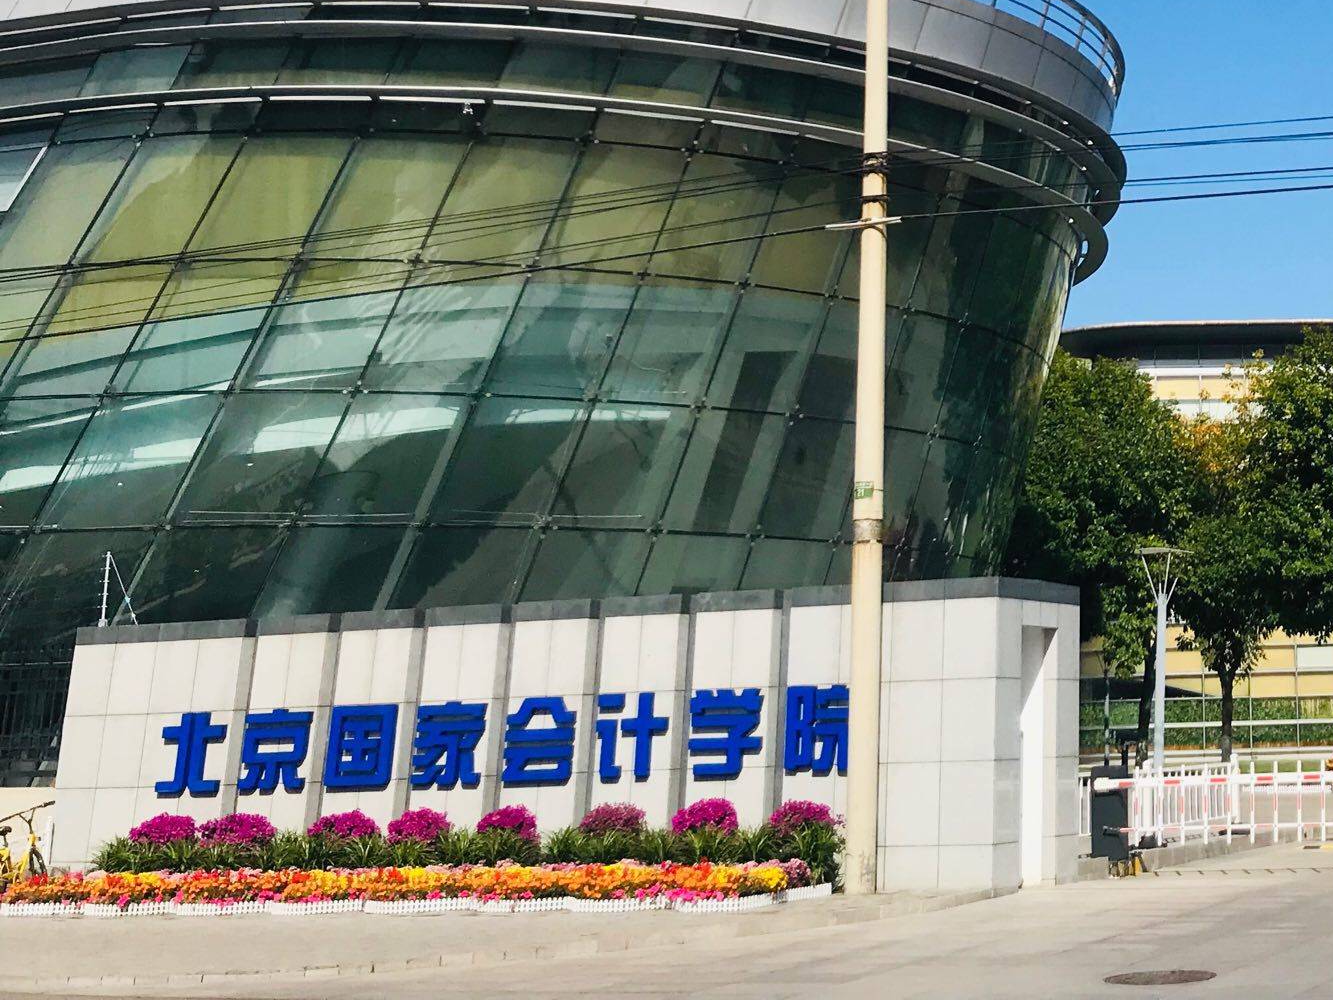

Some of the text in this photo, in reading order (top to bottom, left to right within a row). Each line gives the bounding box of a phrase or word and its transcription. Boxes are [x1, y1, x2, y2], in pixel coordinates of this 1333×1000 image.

[155, 685, 849, 798] 北京国家会计学院
